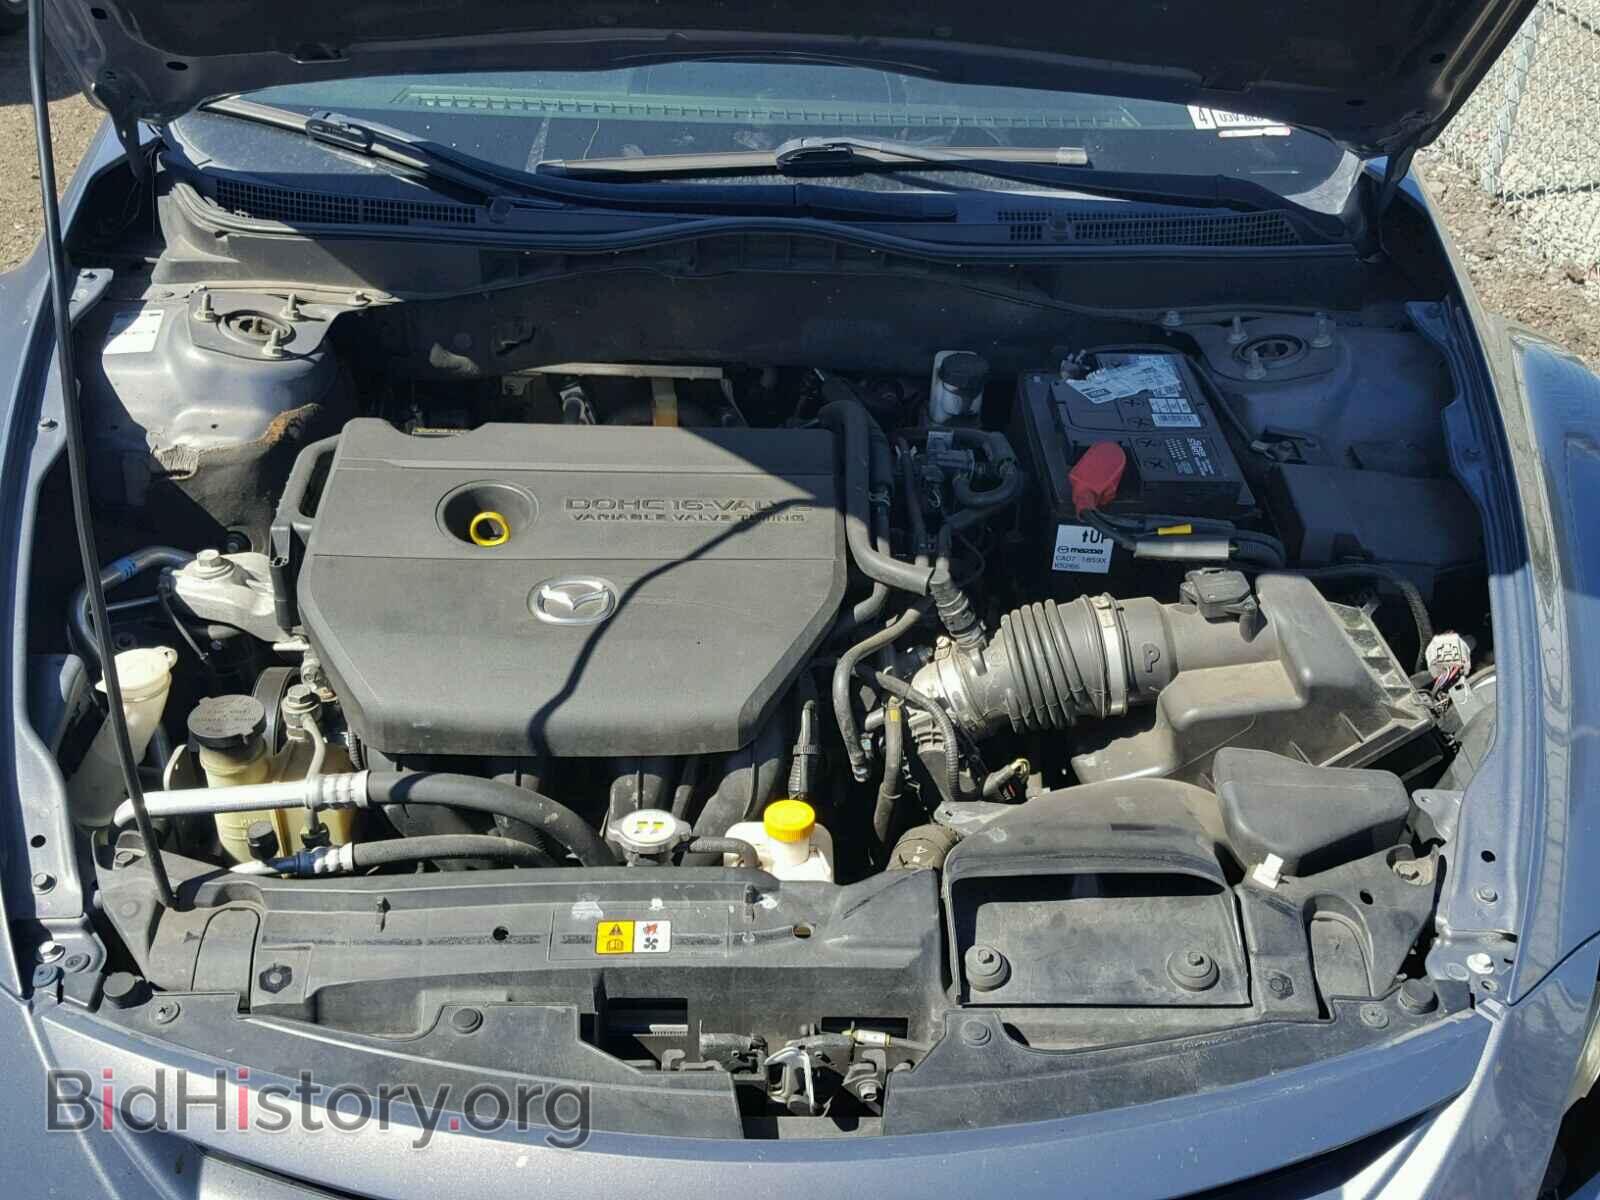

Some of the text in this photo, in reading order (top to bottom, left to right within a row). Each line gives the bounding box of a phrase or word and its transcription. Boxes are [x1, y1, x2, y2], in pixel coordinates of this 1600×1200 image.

[565, 498, 665, 511] DOHC
[573, 513, 805, 522] VARIABLE VALVE TING
[1070, 547, 1103, 555] mazda
[1142, 643, 1160, 673] P
